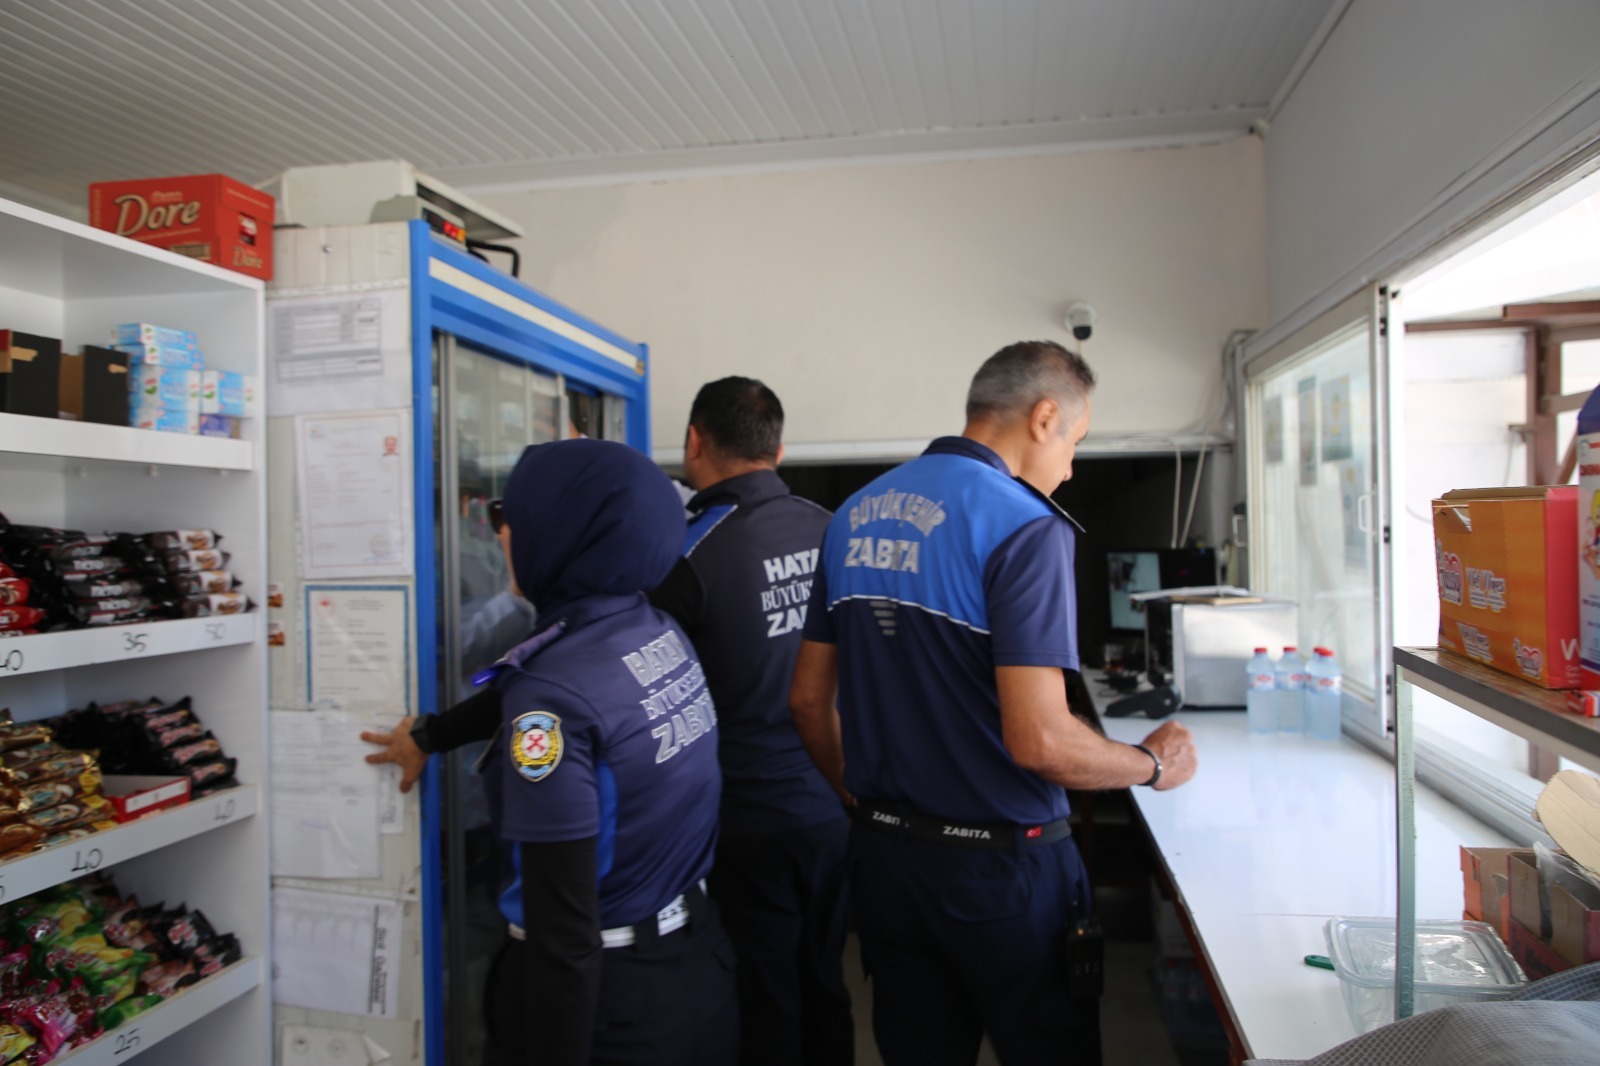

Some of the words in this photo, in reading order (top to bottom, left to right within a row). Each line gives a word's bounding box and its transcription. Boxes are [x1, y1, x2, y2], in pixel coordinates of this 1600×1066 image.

[113, 194, 201, 237] Dore
[121, 630, 150, 653] 35
[942, 825, 992, 840] ZABITA
[113, 1027, 141, 1056] 25
